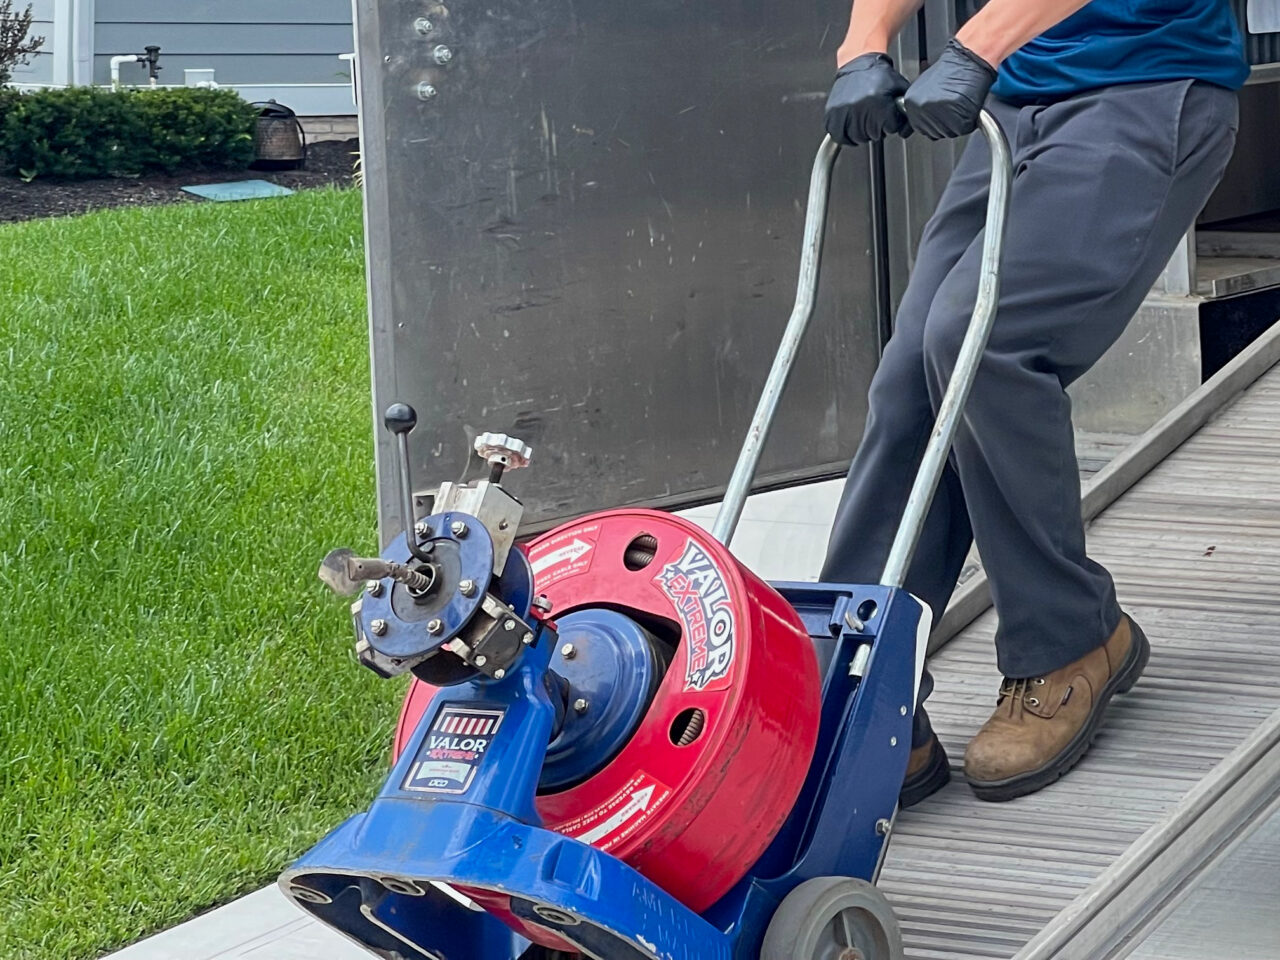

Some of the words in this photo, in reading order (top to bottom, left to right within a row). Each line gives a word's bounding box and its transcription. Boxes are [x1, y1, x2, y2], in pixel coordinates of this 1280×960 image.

[668, 572, 708, 674] EXTREME
[676, 541, 733, 686] VALOR
[429, 735, 487, 752] VALOR
[608, 786, 634, 810] REVERSE
[646, 790, 669, 815] OPERATE
[621, 815, 646, 838] MACHINE
